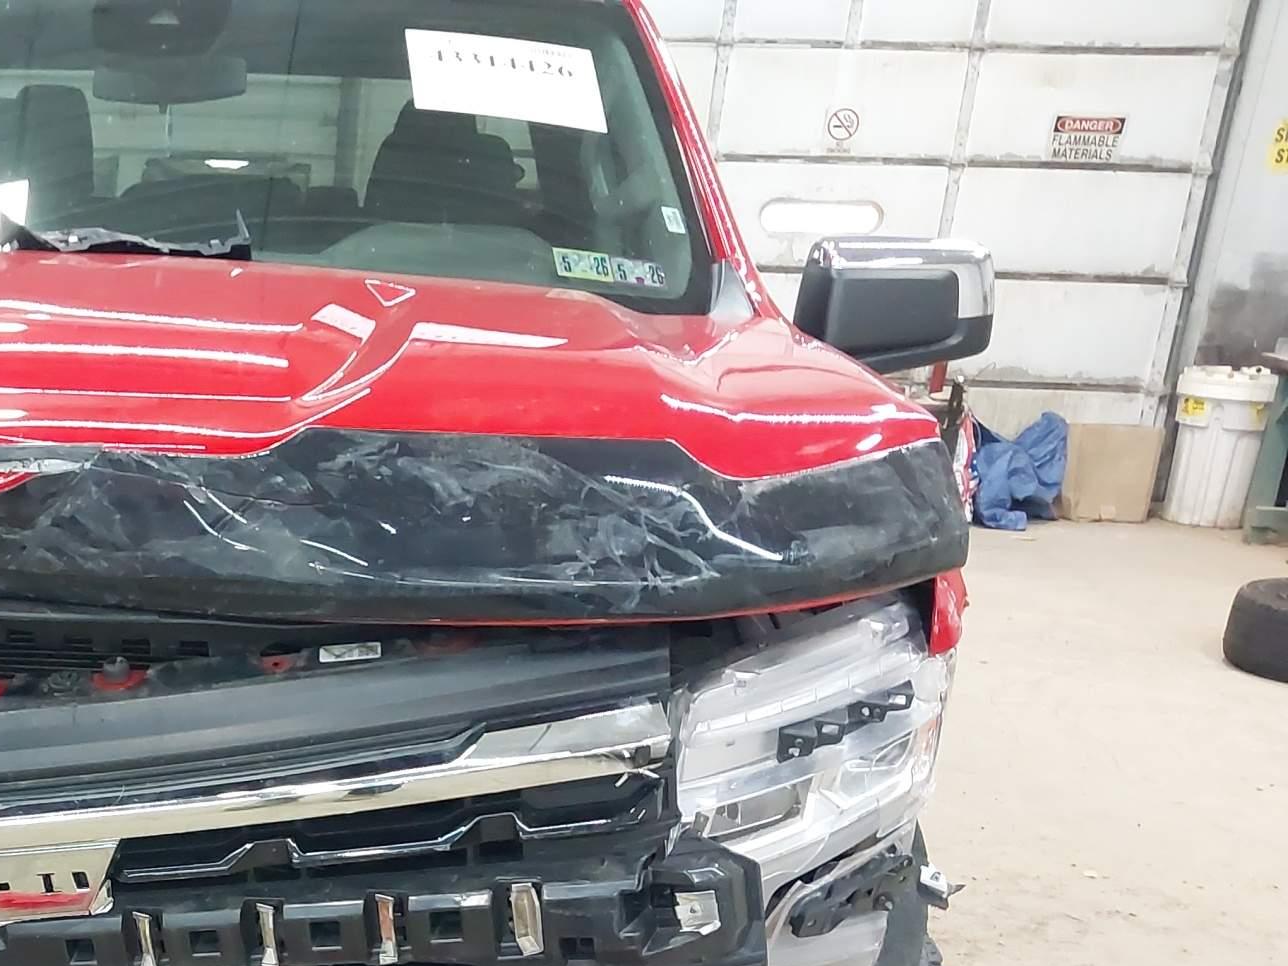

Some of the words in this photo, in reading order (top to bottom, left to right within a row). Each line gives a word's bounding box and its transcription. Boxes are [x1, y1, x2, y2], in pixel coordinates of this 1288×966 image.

[1064, 119, 1114, 131] DANGER
[1052, 134, 1120, 148] FLAMMABLE
[1052, 147, 1113, 161] MATERIALS
[561, 256, 572, 273] 5
[593, 256, 609, 277] 26
[616, 263, 627, 281] 5
[648, 265, 664, 285] 26
